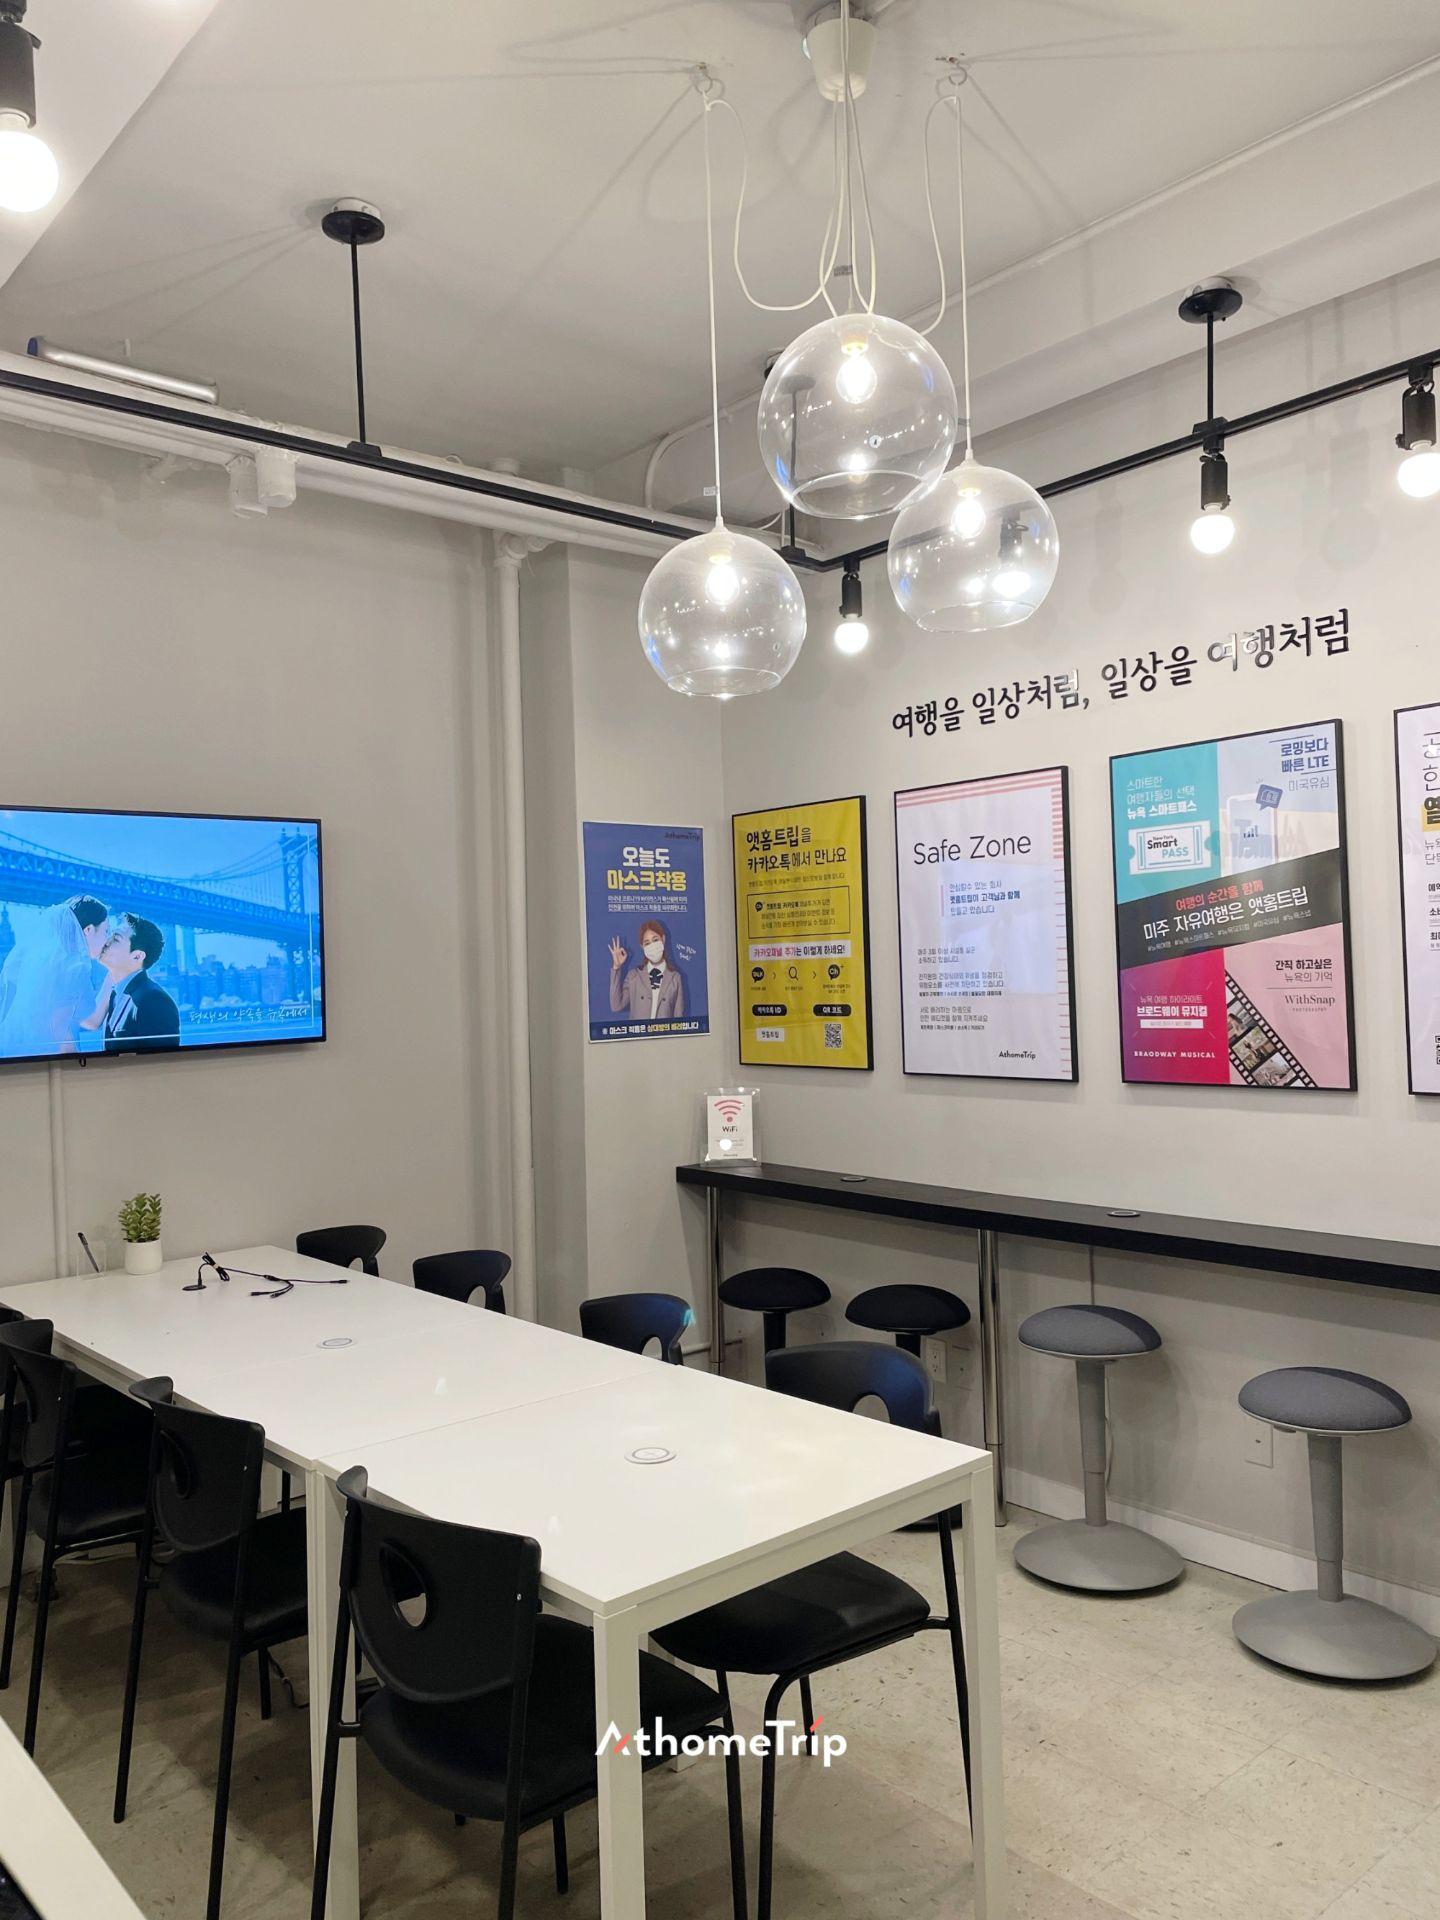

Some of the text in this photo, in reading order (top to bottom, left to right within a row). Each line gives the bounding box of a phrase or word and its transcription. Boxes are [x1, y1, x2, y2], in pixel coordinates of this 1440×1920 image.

[892, 608, 1350, 738] 여행을 일상처럼, 일상을 여행처럼
[1281, 737, 1329, 757] 로밍보다
[1281, 755, 1329, 773] 빠른 LTE
[1127, 776, 1163, 791] 스마트한
[1289, 776, 1330, 792] 미국유심
[1127, 800, 1197, 820] 뉴욕 스마트패스
[746, 825, 812, 853] 앳홈트립을
[1147, 838, 1178, 849] Smart
[622, 847, 671, 868] 오늘도
[913, 834, 1032, 866] Safe Zone
[1162, 846, 1189, 858] PASS
[747, 847, 847, 874] 카카오톡에서 만나요
[607, 869, 687, 891] 마스크착용
[981, 892, 1006, 902] 고객님과
[1175, 879, 1264, 912] 여행의 순간을 함께
[1143, 886, 1308, 940] 미주 자유여행은 앳홈트립
[1275, 959, 1333, 971] 간직 하고싶은
[1315, 972, 1333, 982] 기억
[1284, 994, 1335, 1007] WithSnap
[233, 1007, 263, 1024] 약속을
[267, 1005, 307, 1024] 뉴욕에서
[1137, 1005, 1208, 1017] 브로드웨이 뮤지컬
[609, 1026, 627, 1035] 마스크
[998, 1050, 1037, 1061] AthomeTrip
